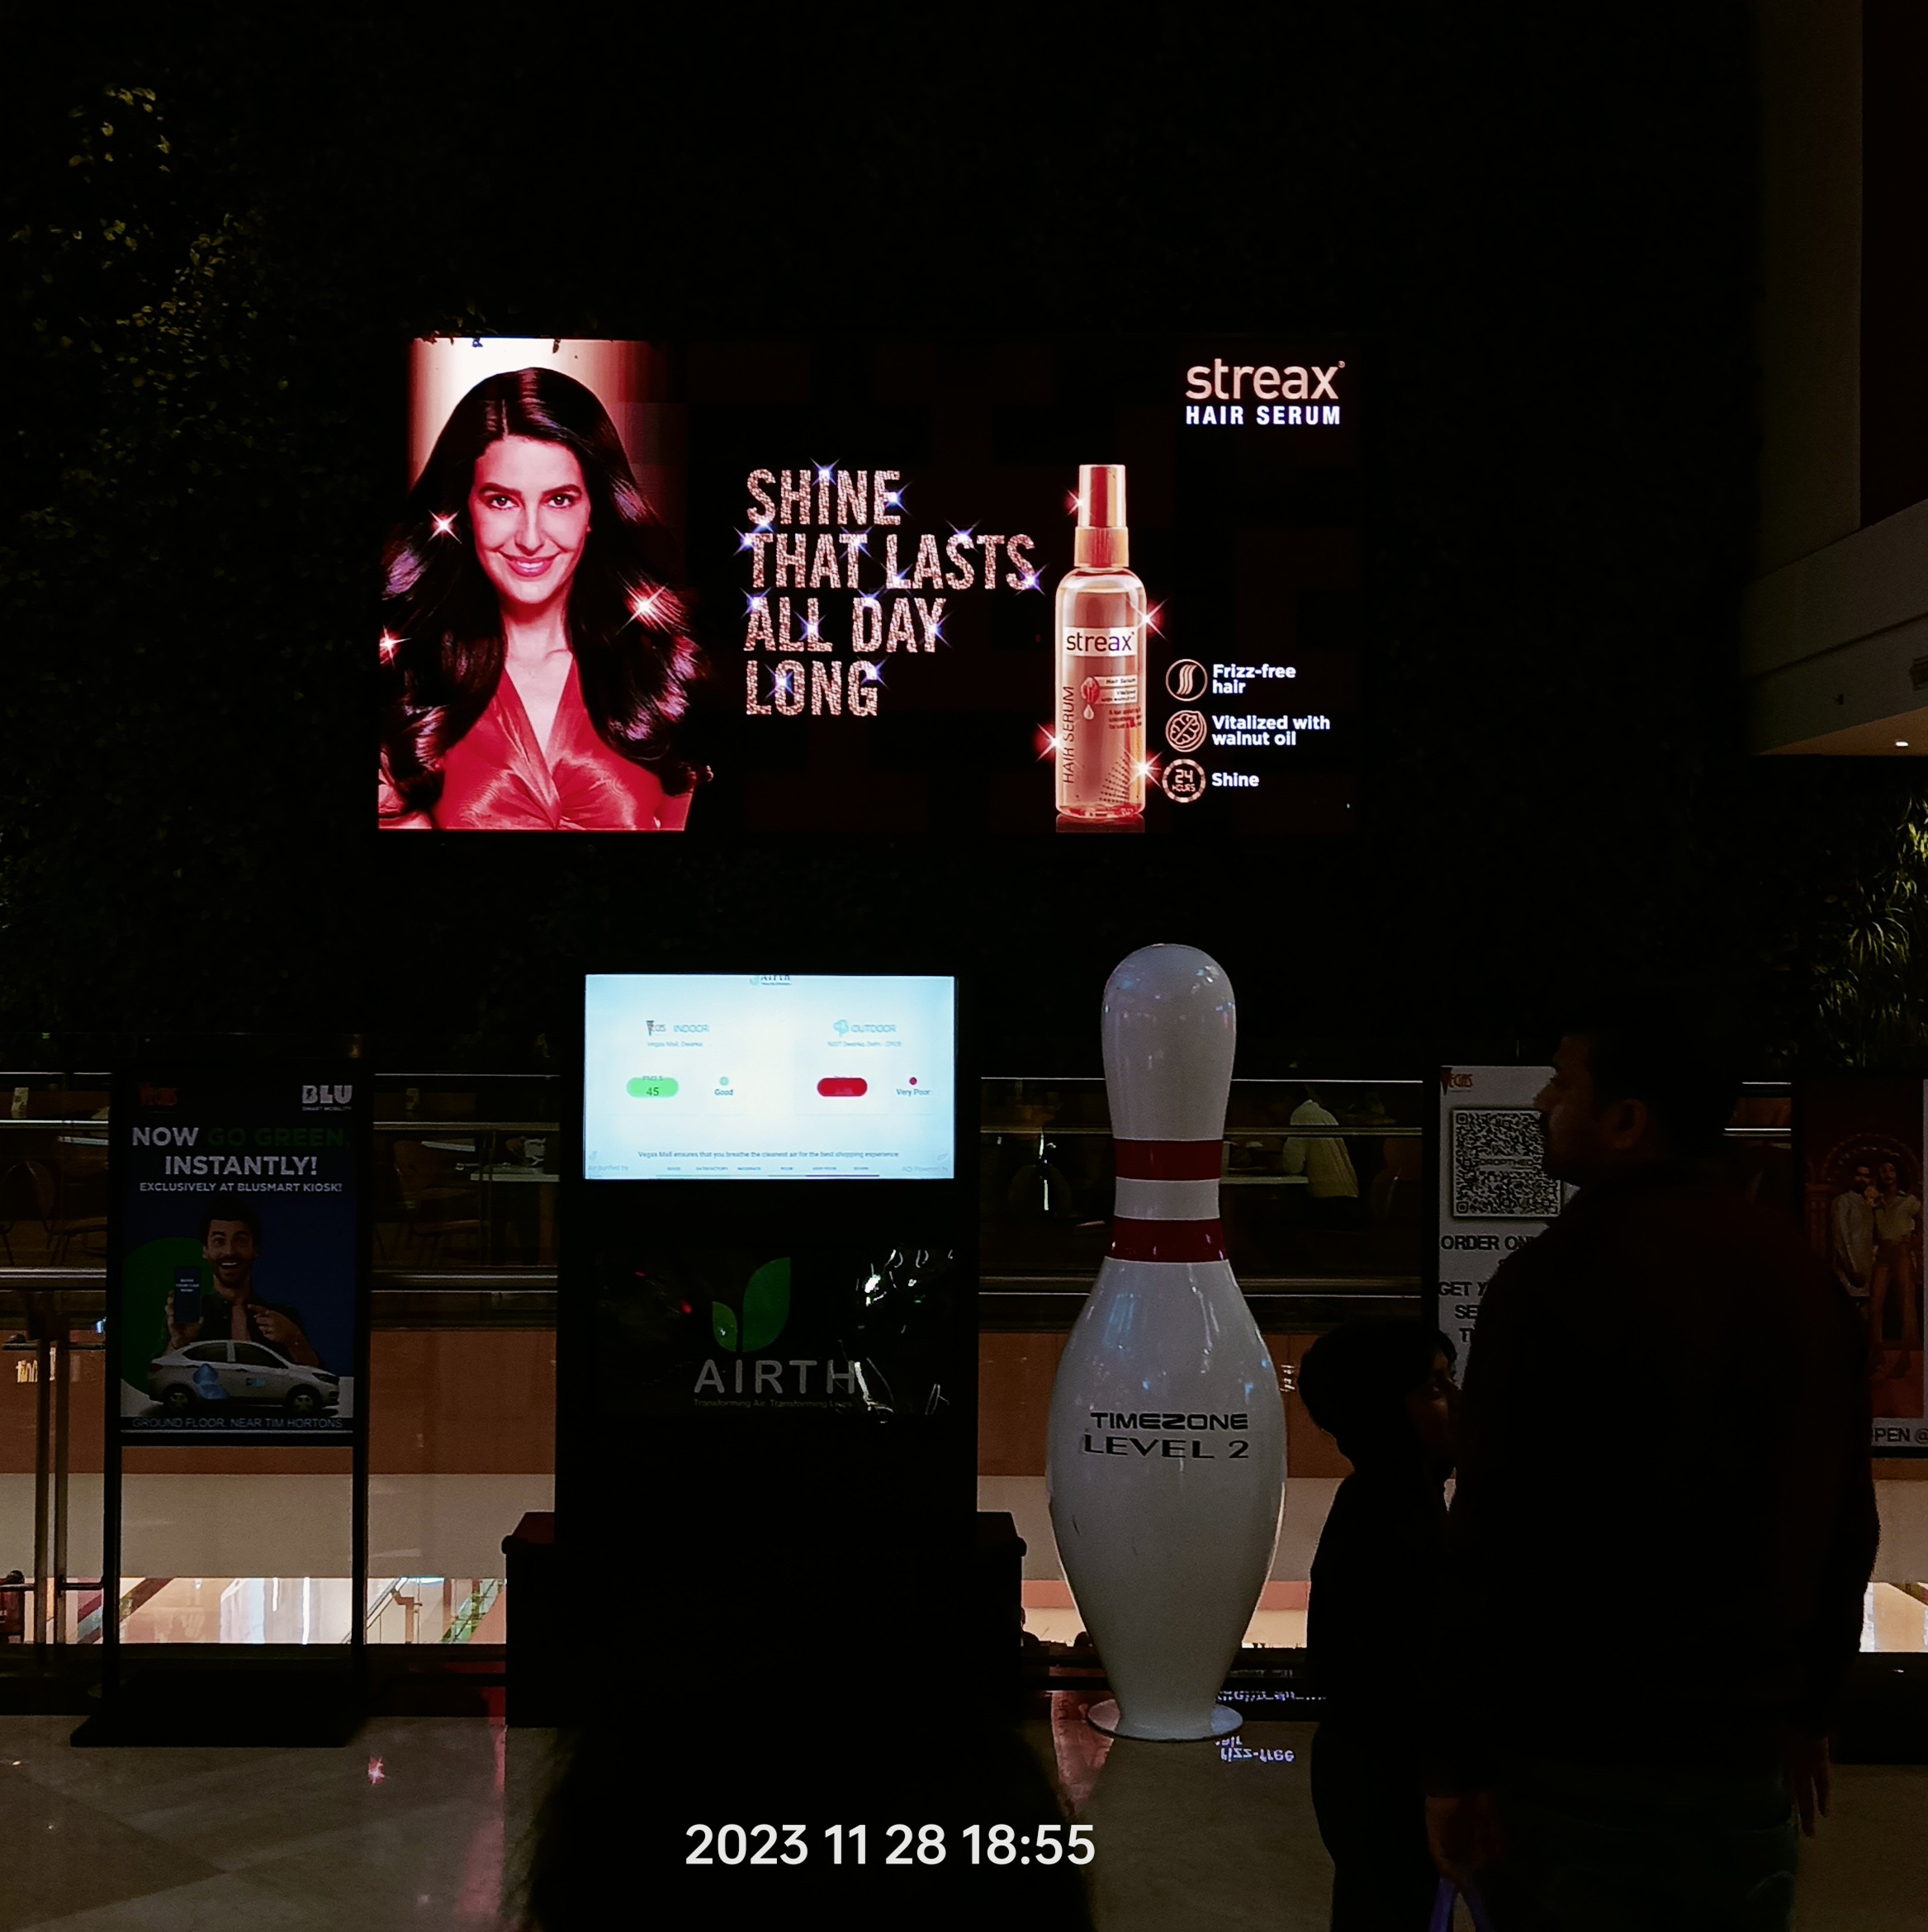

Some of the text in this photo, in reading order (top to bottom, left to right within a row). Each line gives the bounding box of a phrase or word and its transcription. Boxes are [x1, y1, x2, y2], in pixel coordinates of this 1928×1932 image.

[1186, 358, 1338, 400] streax
[1186, 405, 1340, 425] HAIR SERUM
[746, 467, 902, 526] SHINE
[744, 533, 1035, 590] THAT LASTS
[743, 595, 947, 653] ALL DAY
[1066, 632, 1132, 651] streax
[1212, 664, 1296, 678] Frizz-free
[746, 660, 879, 717] LONG
[1212, 680, 1246, 694] hair
[1211, 715, 1330, 730] Vitalized with
[1063, 686, 1074, 784] HAIR SERUM
[1211, 731, 1296, 746] walnut oil
[1175, 769, 1194, 784] 24
[1211, 772, 1260, 787] Shine
[1172, 784, 1196, 793] HOURS
[673, 1024, 710, 1033] INDOOR
[851, 1024, 898, 1033] OUTDOOR
[301, 1084, 353, 1105] BLU
[646, 1087, 660, 1096] 45
[714, 1088, 734, 1096] Good
[896, 1088, 912, 1097] Very
[131, 1127, 200, 1147] NOW
[207, 1128, 247, 1147] GO
[164, 1156, 318, 1176] INSTANTLY!
[139, 1182, 343, 1192] EXCLUSIVELY AT BLUSMART KIOSK!
[1441, 1235, 1499, 1250] ORDER
[1438, 1281, 1472, 1296] GET
[694, 1359, 856, 1395] AIRTH
[132, 1418, 183, 1428] GROUND
[230, 1418, 263, 1428] NEAR
[266, 1418, 286, 1428] TIM
[287, 1418, 343, 1428] HORTONS
[1090, 1412, 1248, 1430] TIMEZONE
[1871, 1428, 1910, 1442] PEN
[1083, 1434, 1249, 1459] LEVEL 2
